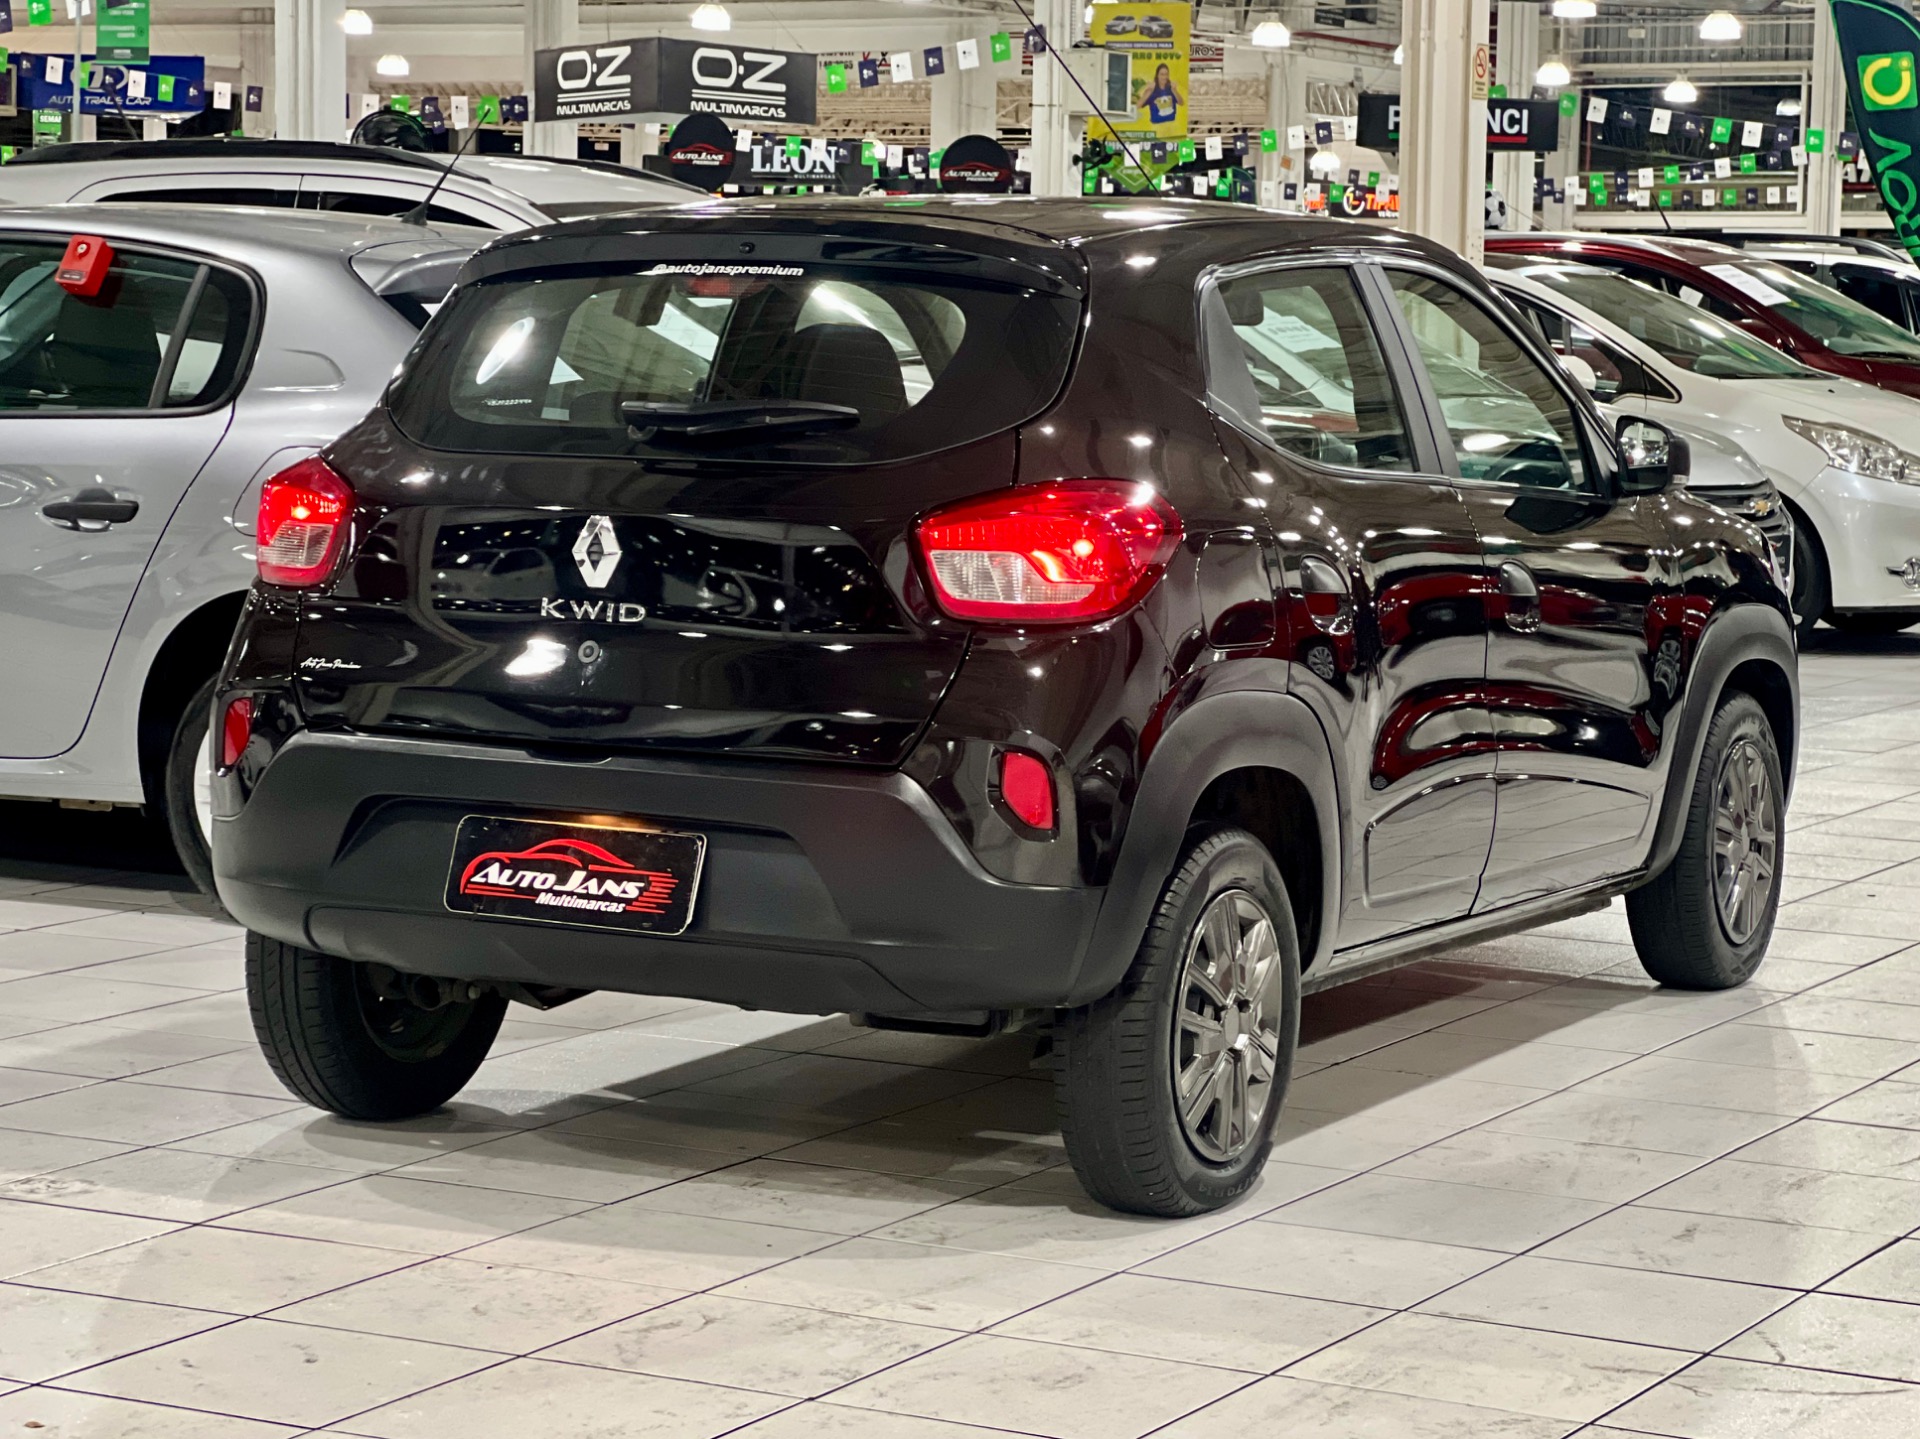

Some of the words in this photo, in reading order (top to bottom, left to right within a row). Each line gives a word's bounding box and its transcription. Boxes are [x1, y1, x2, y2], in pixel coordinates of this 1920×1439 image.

[49, 95, 74, 105] AUT
[126, 96, 152, 105] CAR
[556, 101, 631, 115] MULTIMARCAS
[690, 101, 786, 118] MULTIMARCAS
[652, 263, 804, 276] @autojanspremium
[541, 597, 646, 622] KWID
[535, 892, 626, 913] Multimarcas
